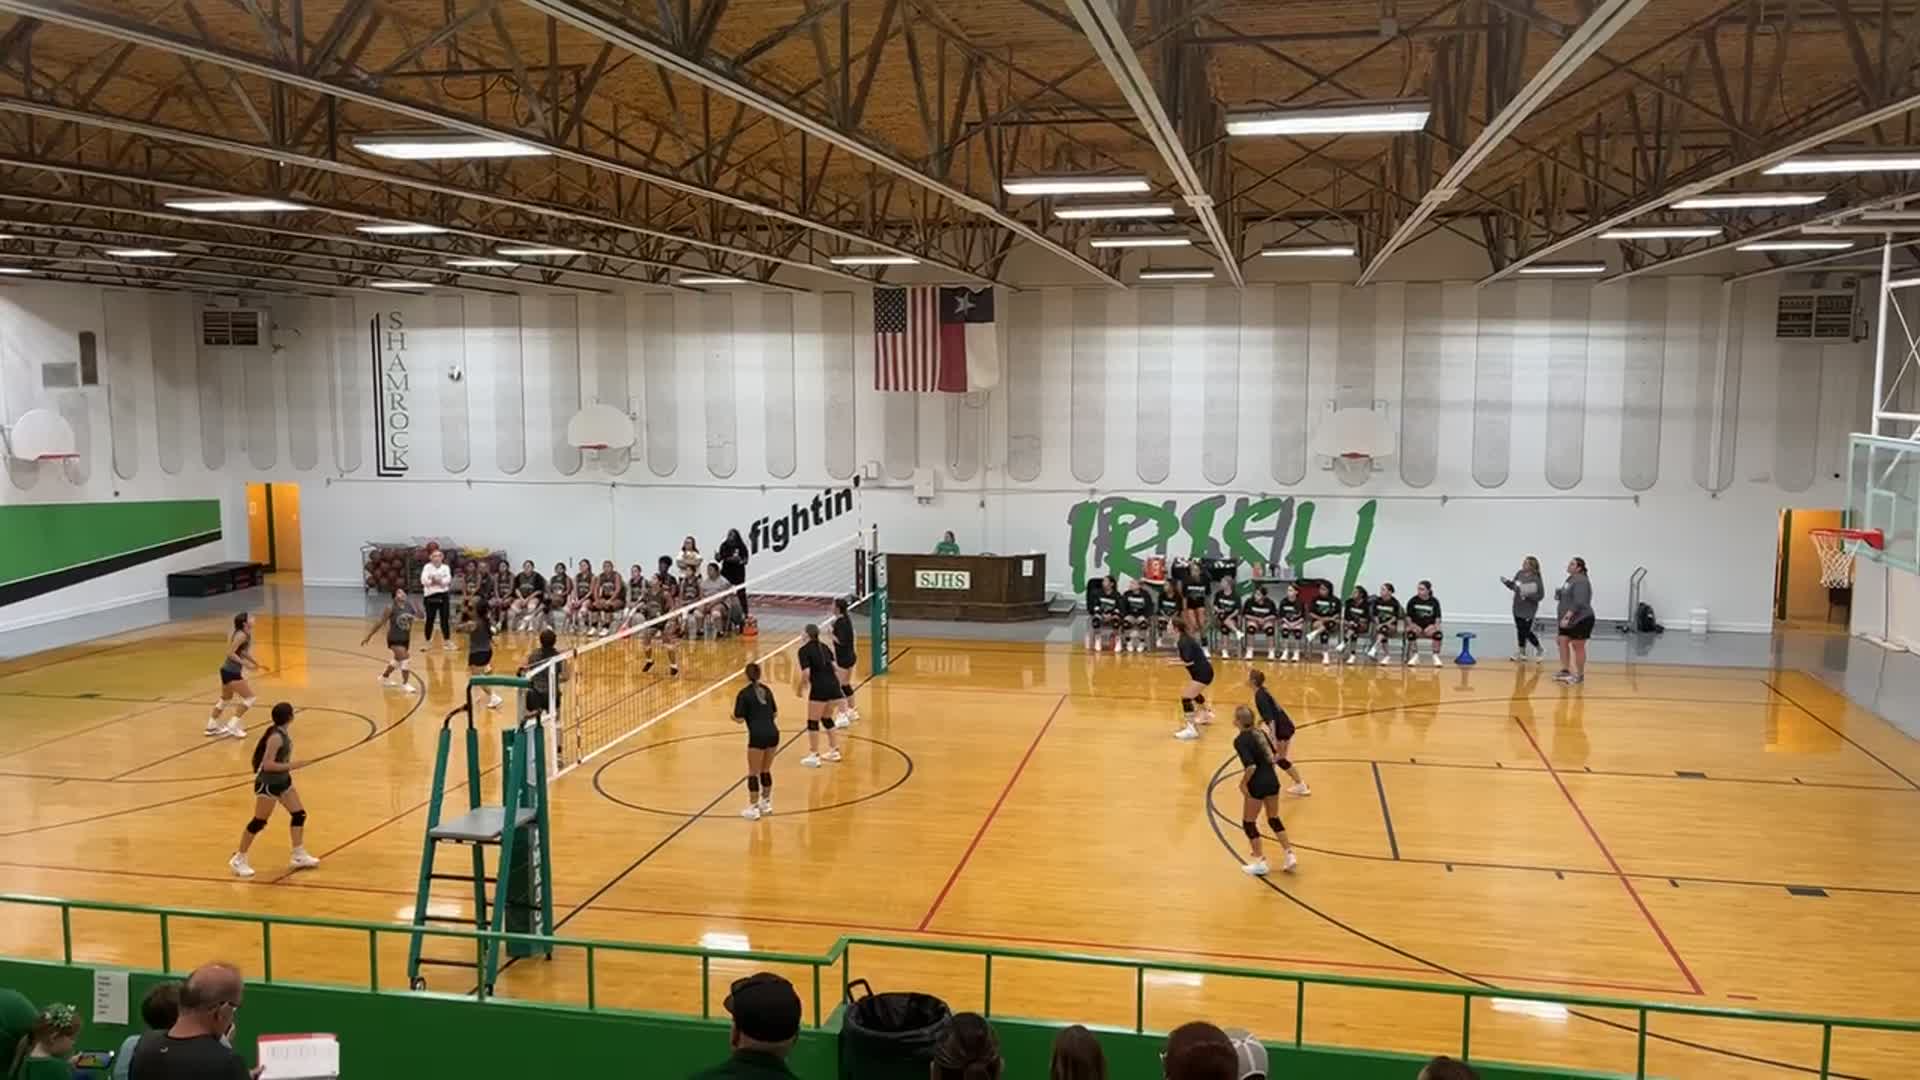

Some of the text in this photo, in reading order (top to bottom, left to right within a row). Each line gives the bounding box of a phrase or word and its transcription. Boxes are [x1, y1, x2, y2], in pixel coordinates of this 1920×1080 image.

[386, 310, 409, 468] SHAMROCK
[748, 474, 861, 555] fightin'
[1068, 495, 1377, 603] IRISH
[920, 572, 966, 588] SJHS
